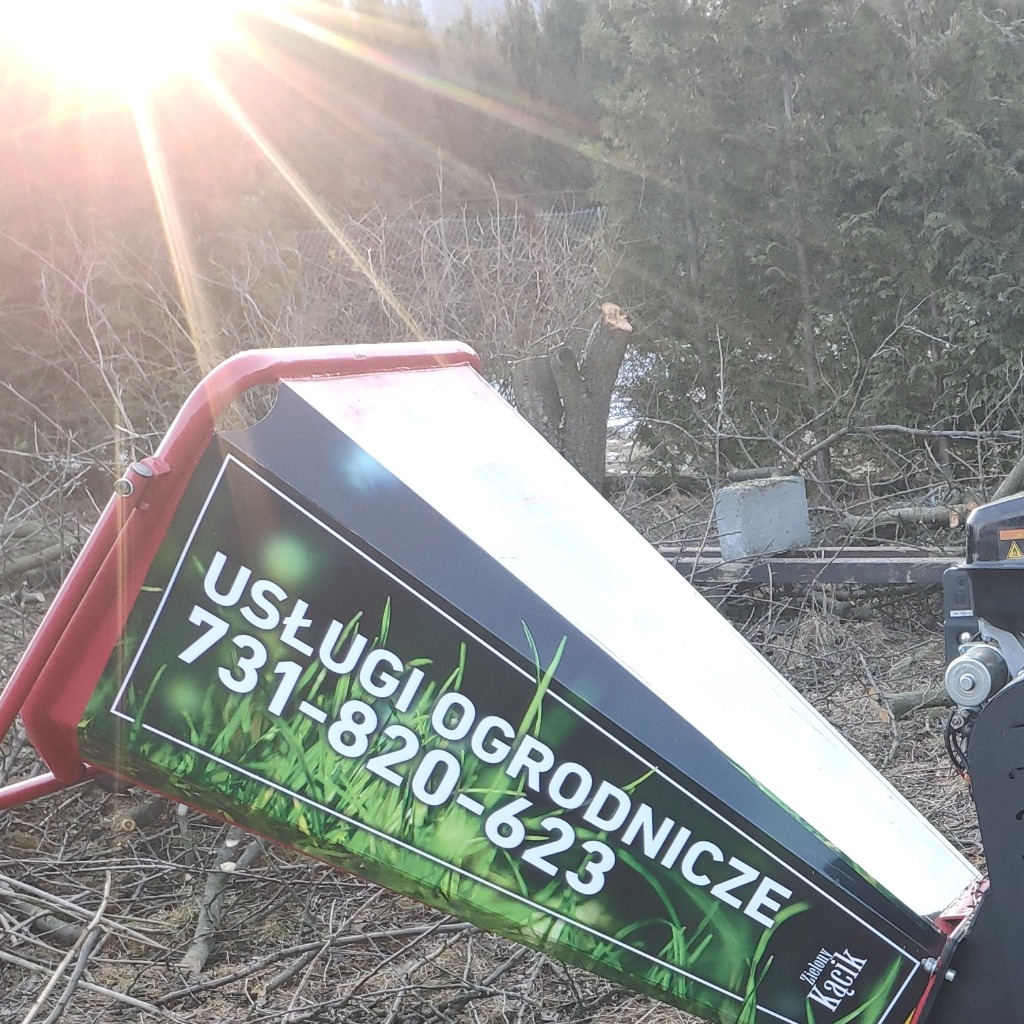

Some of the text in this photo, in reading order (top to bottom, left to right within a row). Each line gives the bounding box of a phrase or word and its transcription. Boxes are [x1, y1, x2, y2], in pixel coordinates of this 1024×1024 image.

[177, 605, 616, 895] 731-820-623
[203, 551, 793, 929] USŁUGI OGRODNICZE
[800, 947, 835, 986] Zielony
[807, 948, 868, 1013] Kącik
